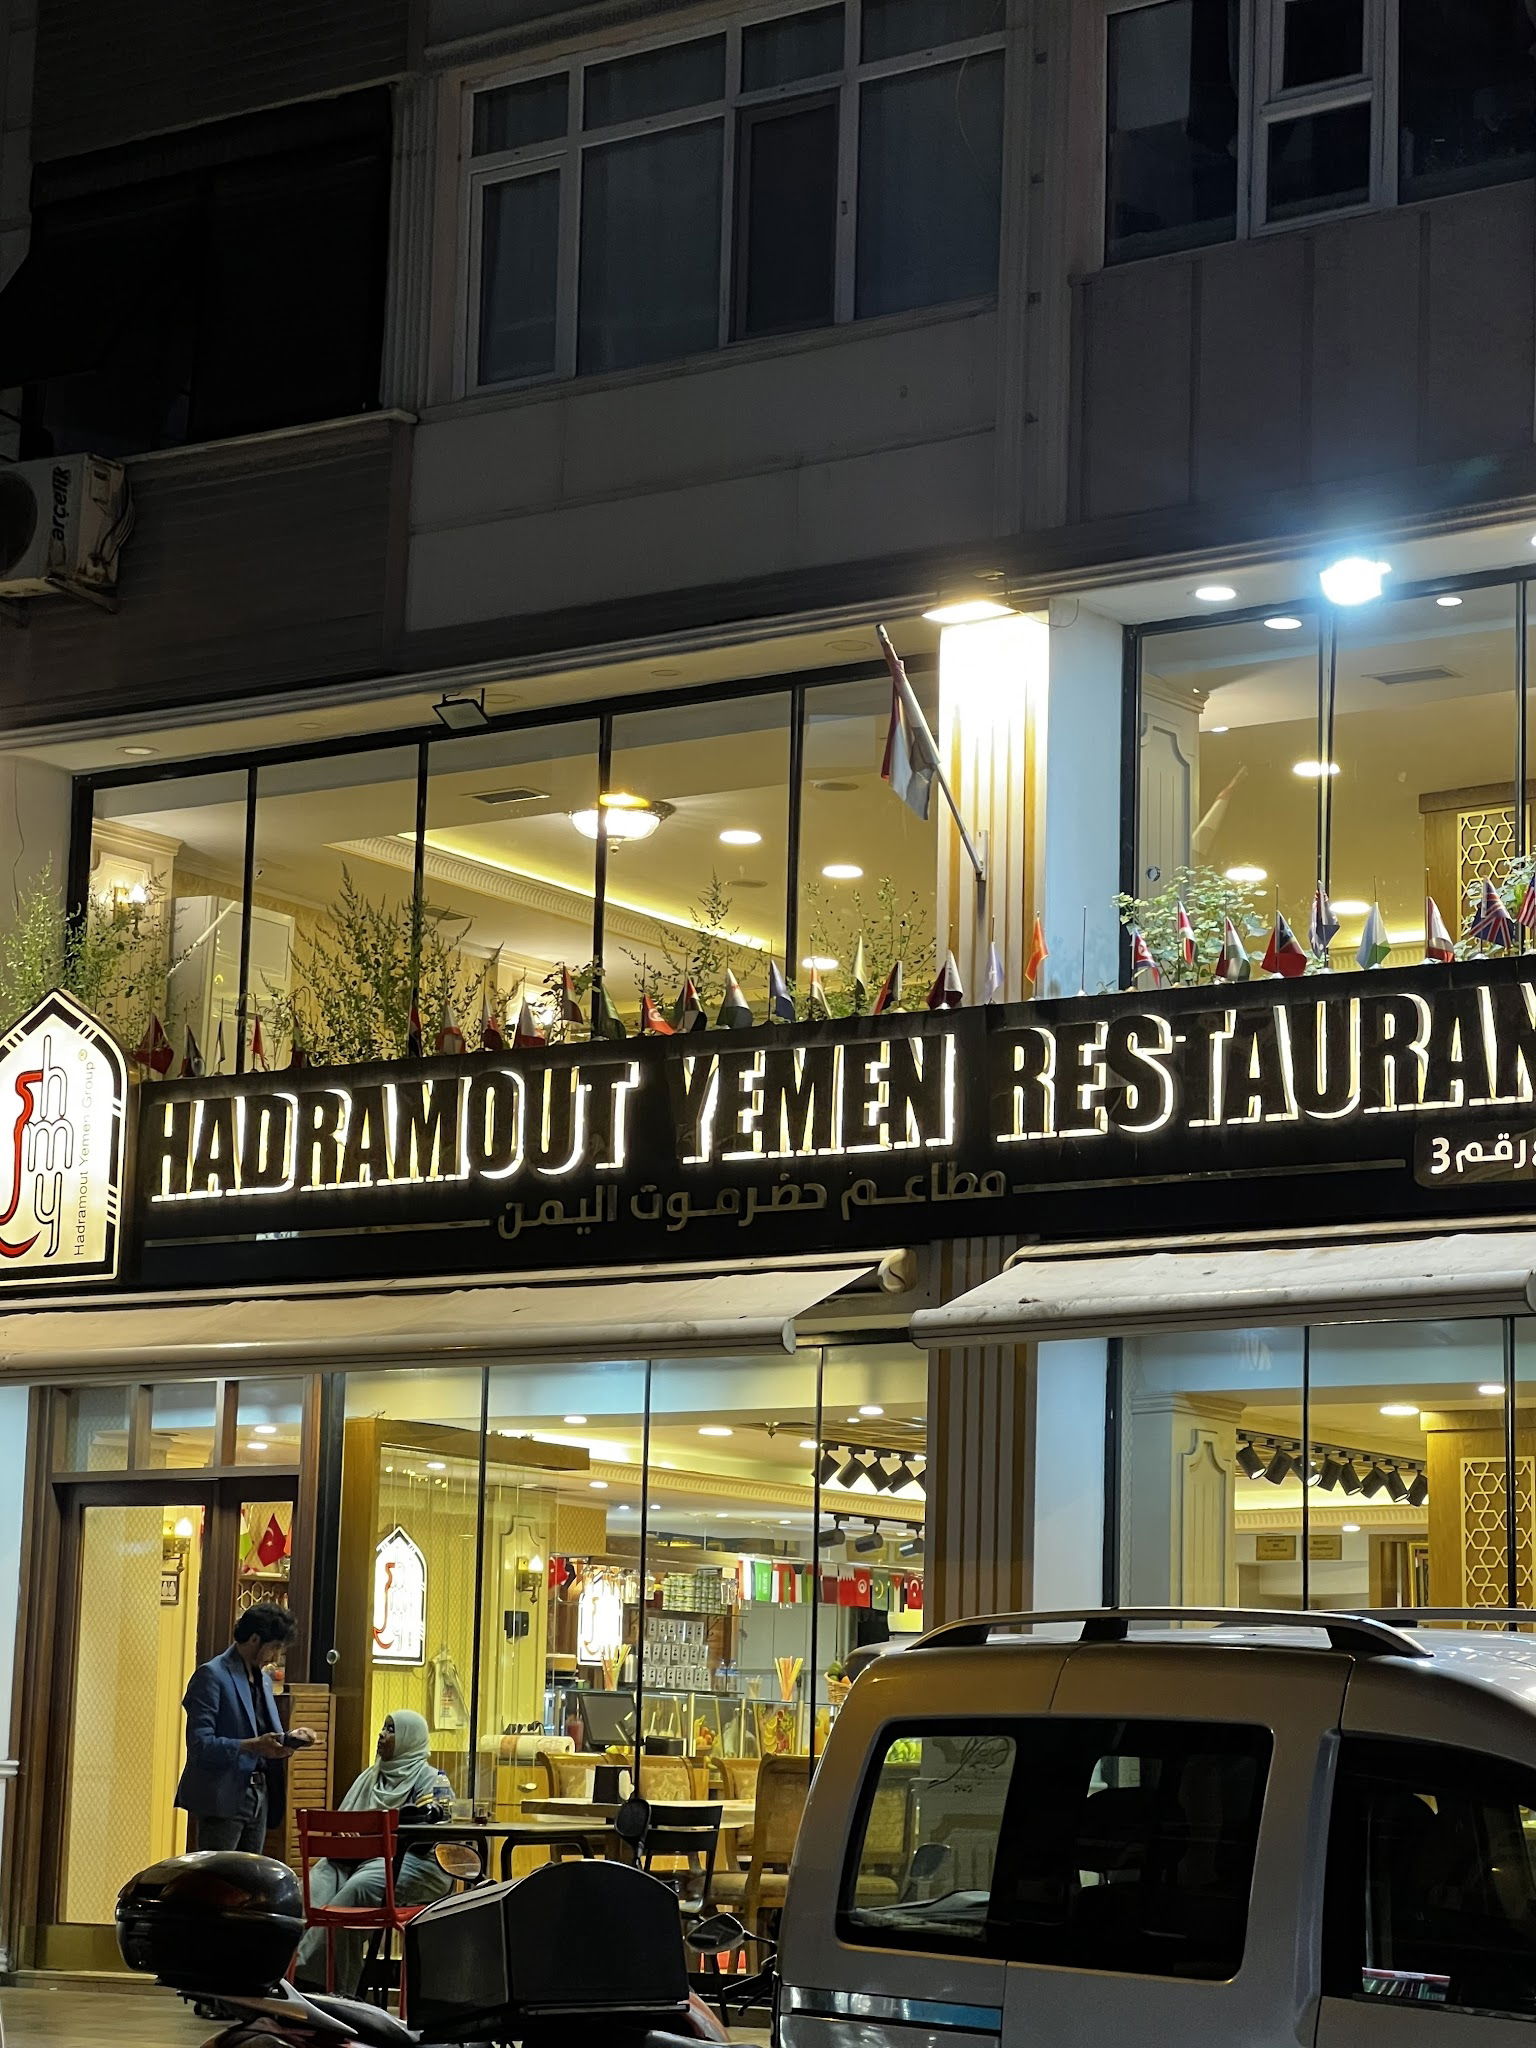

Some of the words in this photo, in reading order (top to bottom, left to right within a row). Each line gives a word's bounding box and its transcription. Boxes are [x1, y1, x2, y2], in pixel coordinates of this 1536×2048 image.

[52, 466, 71, 541] arçelik
[82, 1060, 96, 1109] Group
[79, 1114, 90, 1166] Yemen
[147, 1061, 642, 1203] HADRAMOUT
[670, 1033, 956, 1164] YEMEN
[74, 1171, 88, 1256] Hadramout
[498, 1185, 618, 1240] اليمن
[630, 1173, 828, 1232] حضرموت
[841, 1161, 1007, 1221] مطاعم
